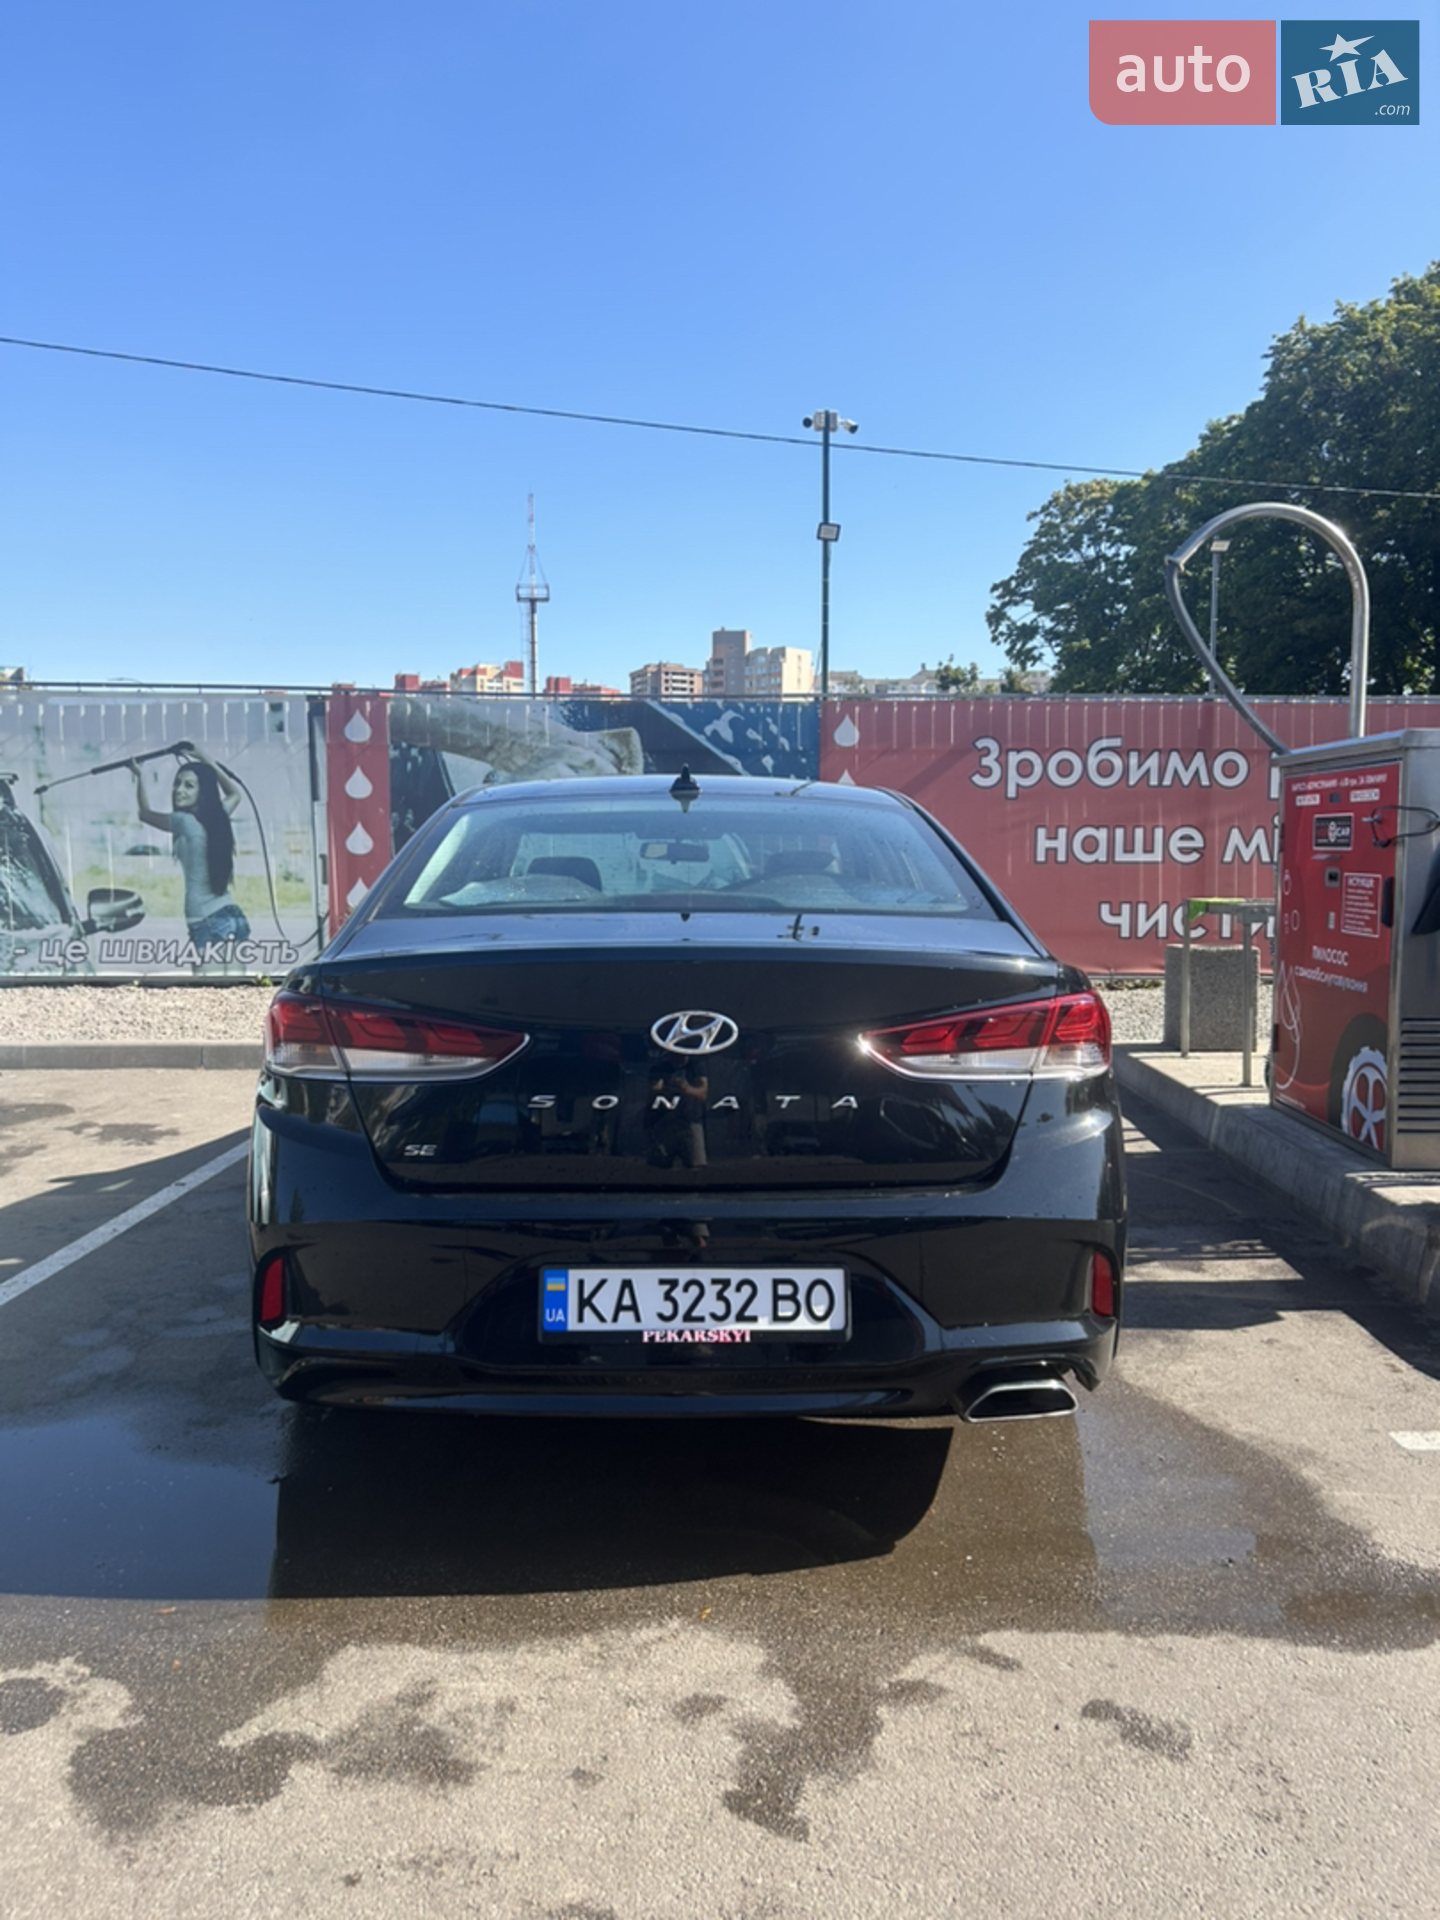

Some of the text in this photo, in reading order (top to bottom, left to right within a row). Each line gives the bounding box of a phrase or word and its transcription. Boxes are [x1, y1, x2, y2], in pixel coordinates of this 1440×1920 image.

[969, 737, 1250, 800] Зробимо
[1034, 825, 1205, 864] наше
[39, 939, 89, 967] це
[99, 934, 299, 967] швидкість
[527, 1094, 860, 1110] SONATA
[404, 1144, 437, 1157] SE
[545, 1307, 566, 1323] UA
[577, 1278, 835, 1324] KA 3232 BO
